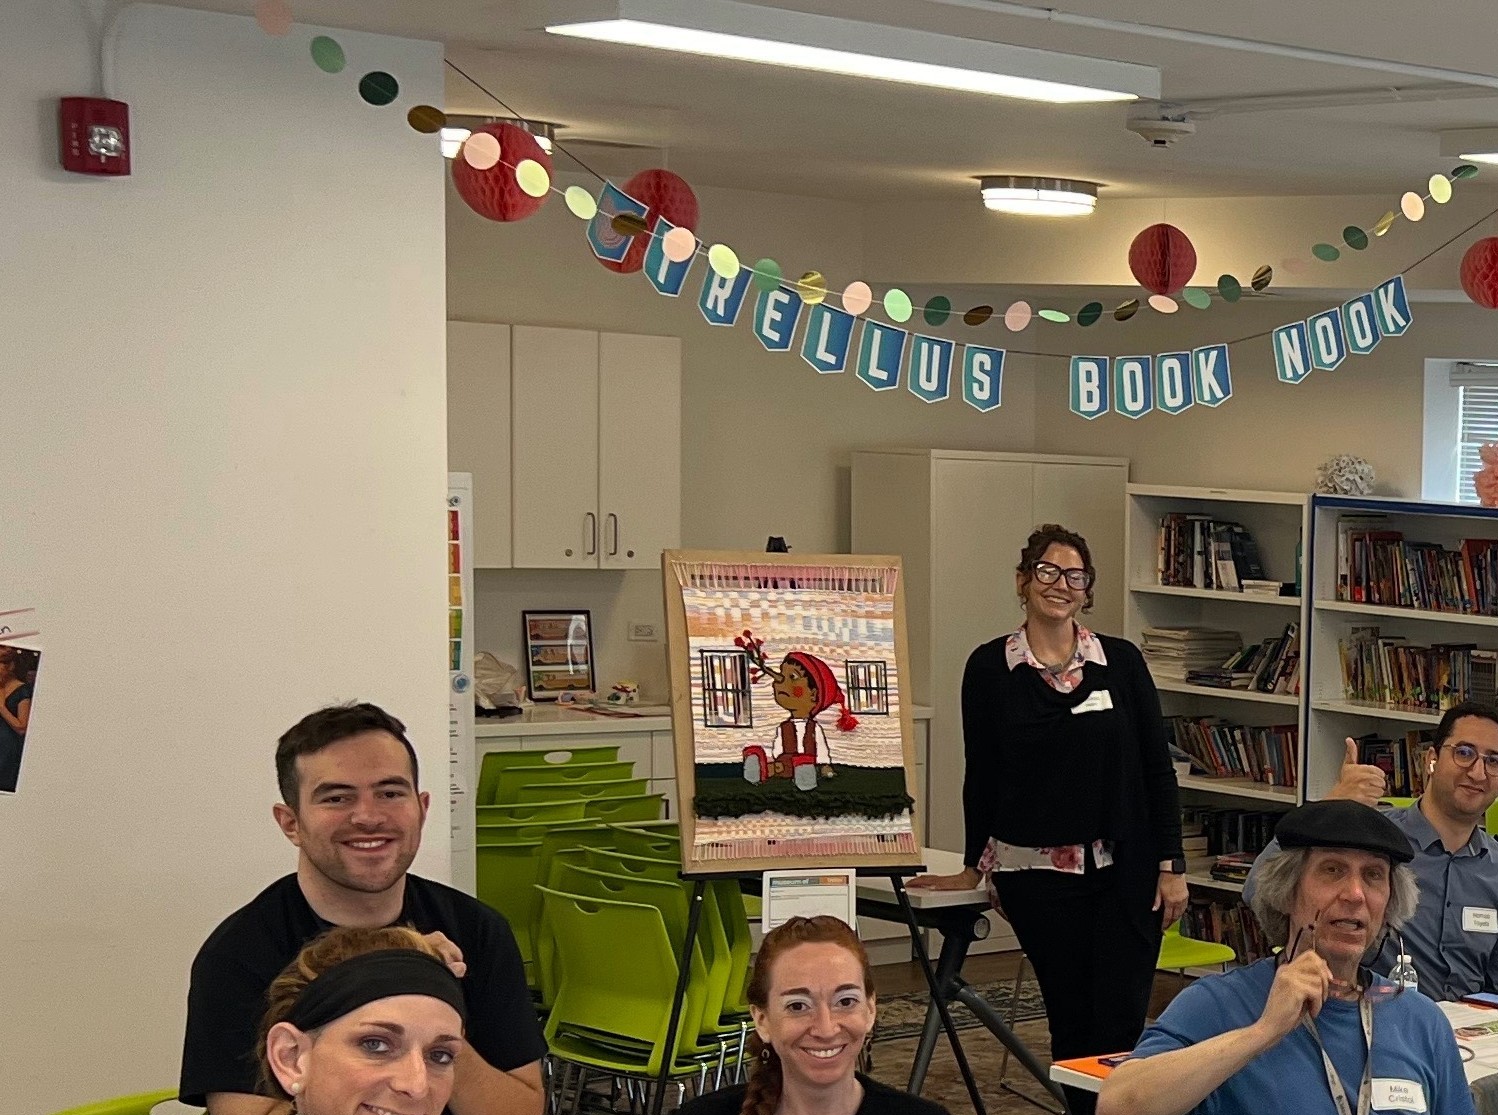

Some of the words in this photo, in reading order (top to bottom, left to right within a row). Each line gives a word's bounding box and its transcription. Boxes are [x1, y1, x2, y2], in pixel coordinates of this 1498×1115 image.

[1079, 351, 1224, 412] BOOK
[1279, 283, 1406, 378] NOOK
[1389, 1085, 1409, 1094] Mike
